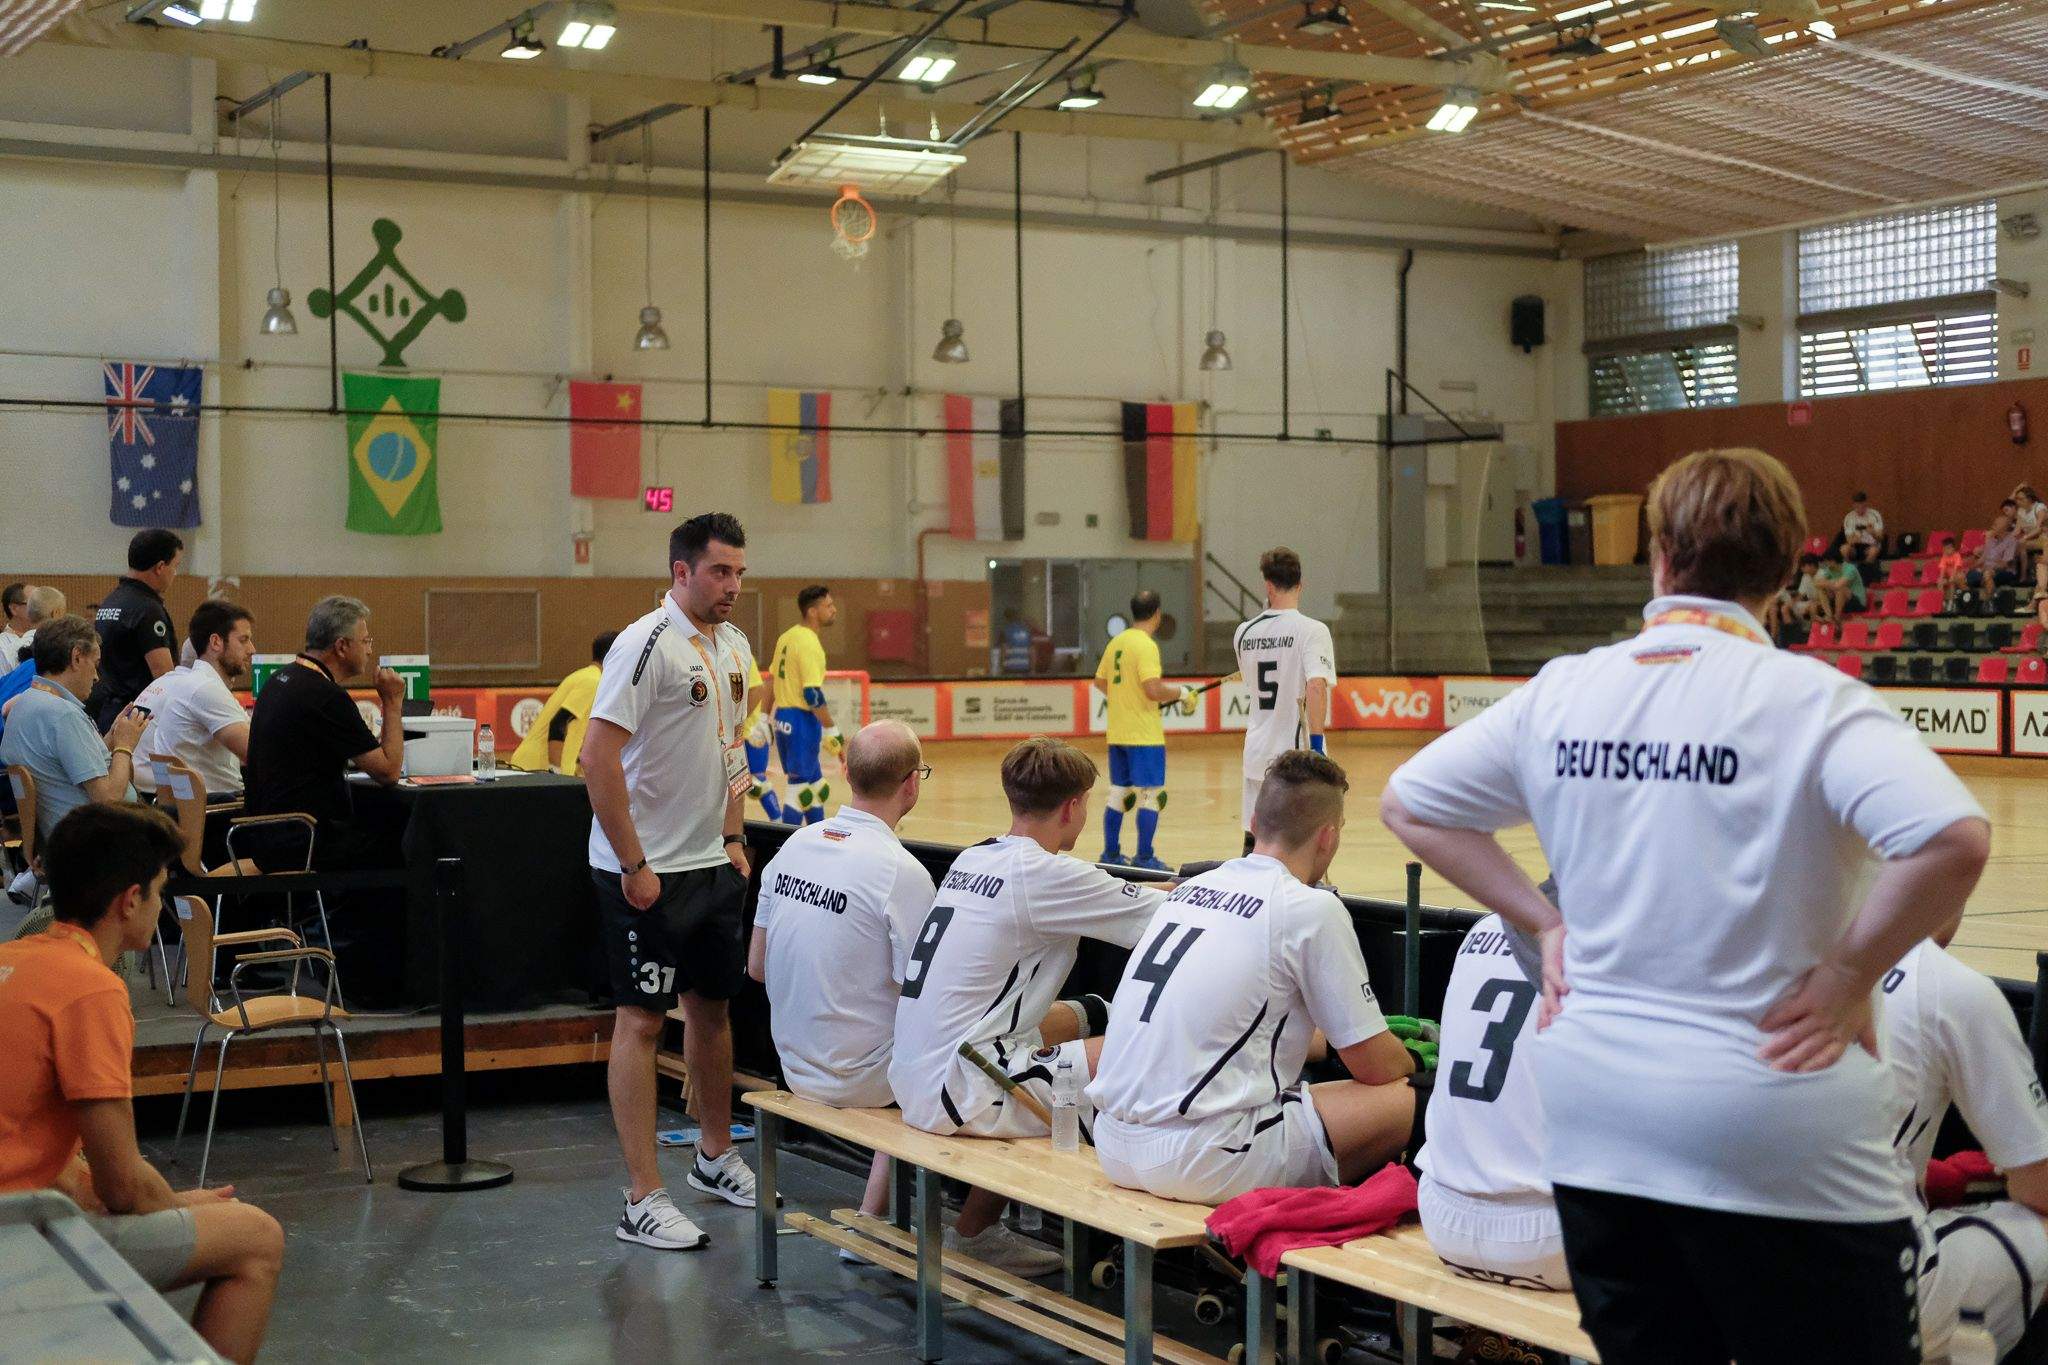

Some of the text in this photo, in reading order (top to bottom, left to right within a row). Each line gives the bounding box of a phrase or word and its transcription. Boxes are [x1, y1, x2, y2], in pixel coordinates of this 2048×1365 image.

[646, 488, 672, 512] 45
[95, 607, 122, 620] EFEREE
[1242, 636, 1295, 651] DEUTSCHLAND
[1258, 661, 1279, 710] 5
[1900, 708, 1987, 734] ZEMAD
[1556, 740, 1739, 784] DEUTSCHLAND
[774, 872, 848, 914] DEUTSCHLAND
[901, 906, 955, 999] 9
[1132, 922, 1206, 1023] 4
[640, 962, 676, 994] 31
[1449, 978, 1538, 1103] 3
